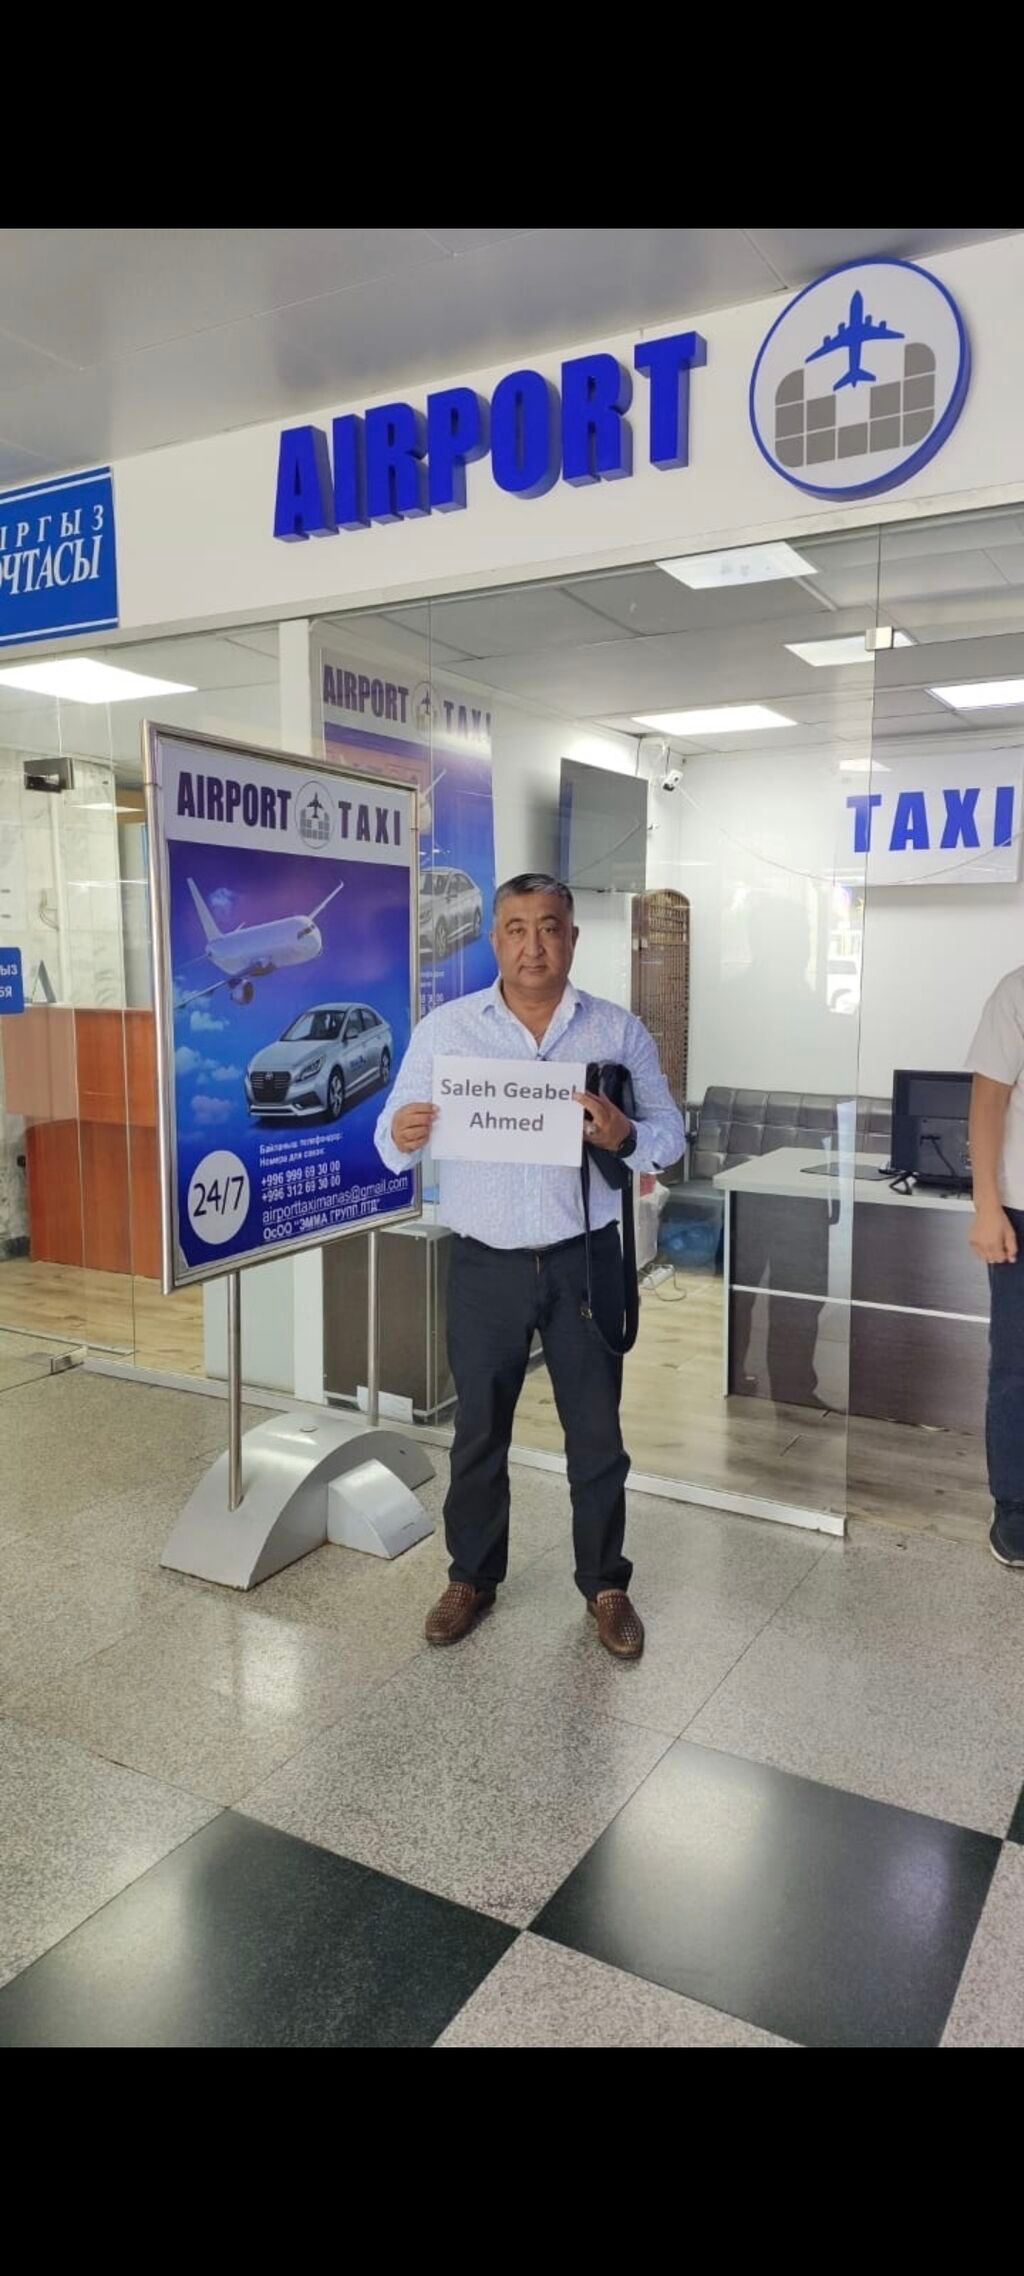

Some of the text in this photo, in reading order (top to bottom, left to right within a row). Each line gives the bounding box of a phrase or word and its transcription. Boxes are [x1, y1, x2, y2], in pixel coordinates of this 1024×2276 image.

[273, 331, 708, 543] AIRPORT
[0, 535, 103, 595] ЧТАСЫ
[323, 664, 491, 742] AIRPORT TAXI
[177, 771, 401, 846] AIRPORT TAXI
[846, 786, 1014, 853] TAXI
[440, 1079, 496, 1098] Saleh
[469, 1111, 544, 1132] Ahmed
[261, 1160, 341, 1187] +996 999 69 30 00
[261, 1174, 341, 1203] +996 312 69 30 00
[193, 1176, 244, 1217] 24/7
[262, 1176, 408, 1224] airporttaximanas@gmail.com
[263, 1221, 293, 1240] ОсОО
[329, 1202, 359, 1223] ГРУПП
